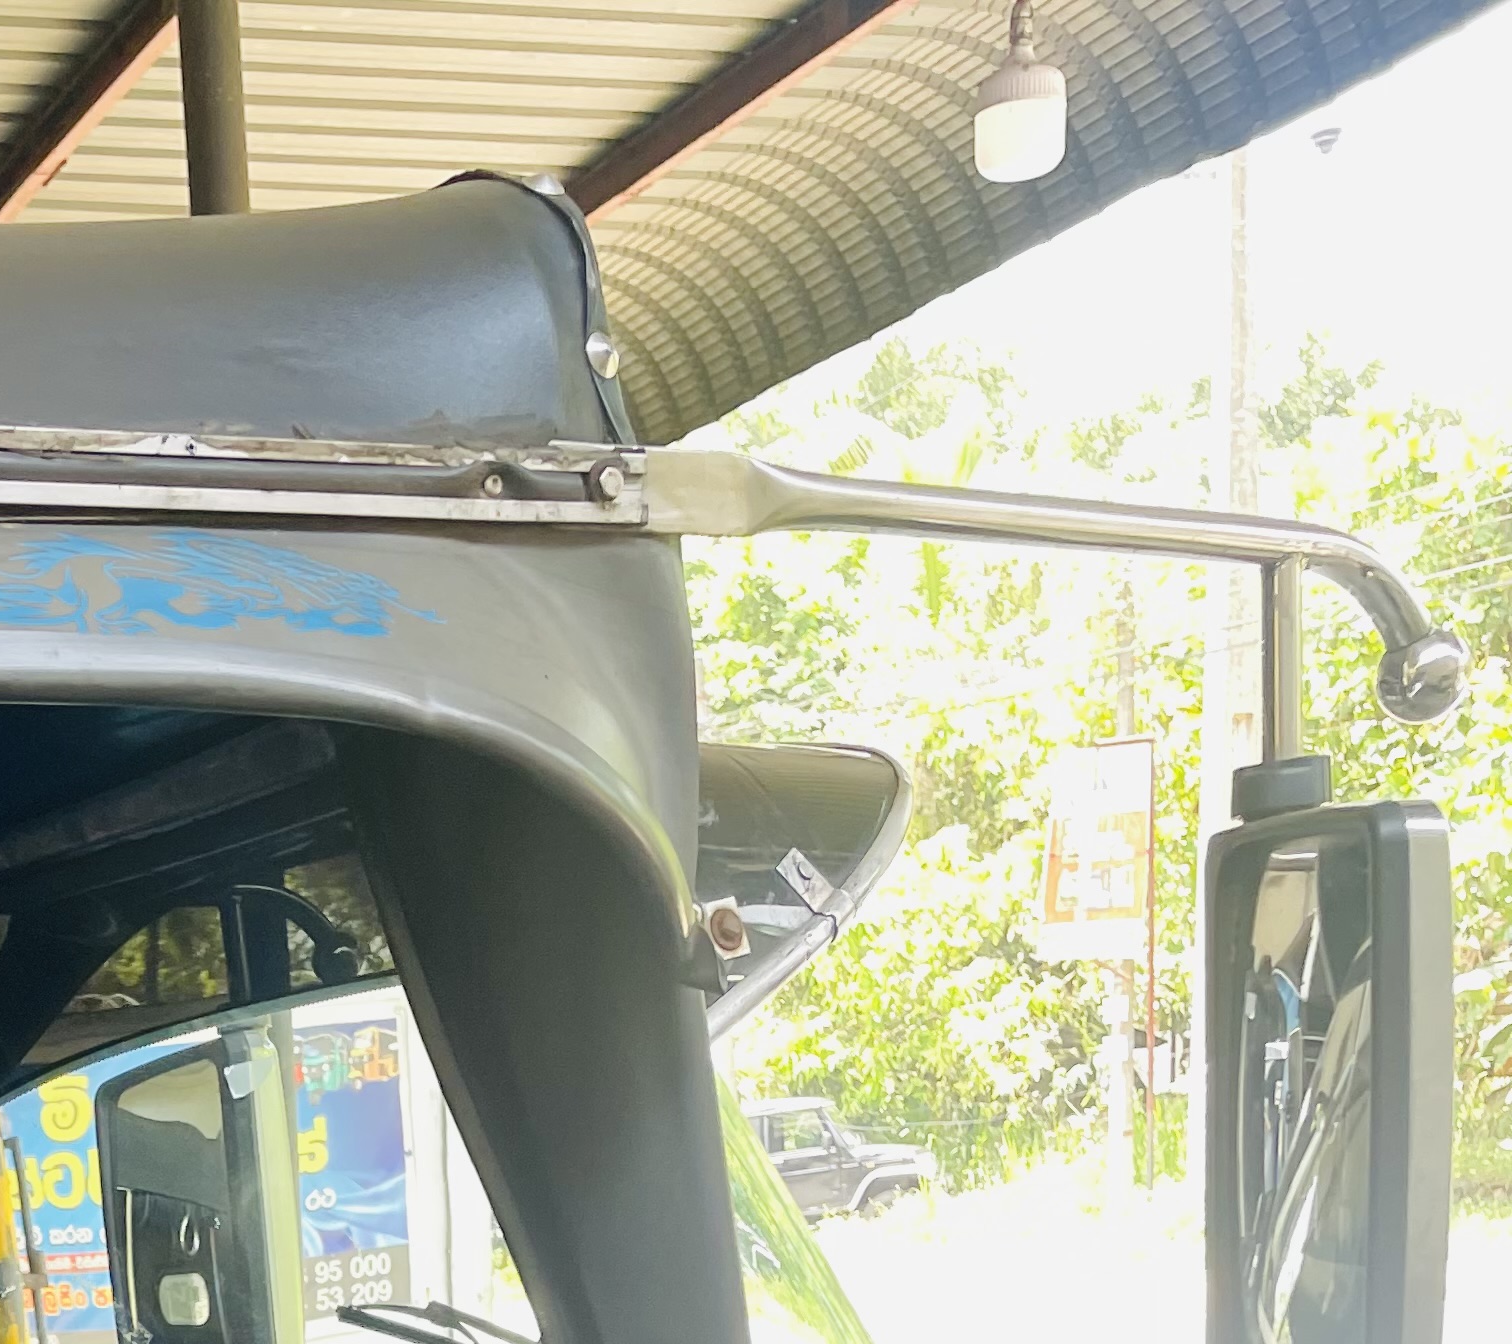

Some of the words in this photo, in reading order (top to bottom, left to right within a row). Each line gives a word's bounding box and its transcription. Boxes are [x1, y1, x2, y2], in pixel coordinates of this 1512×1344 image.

[314, 1260, 343, 1284] 95
[349, 1252, 392, 1279] 000
[316, 1286, 345, 1311] 53
[350, 1279, 393, 1306] 209
